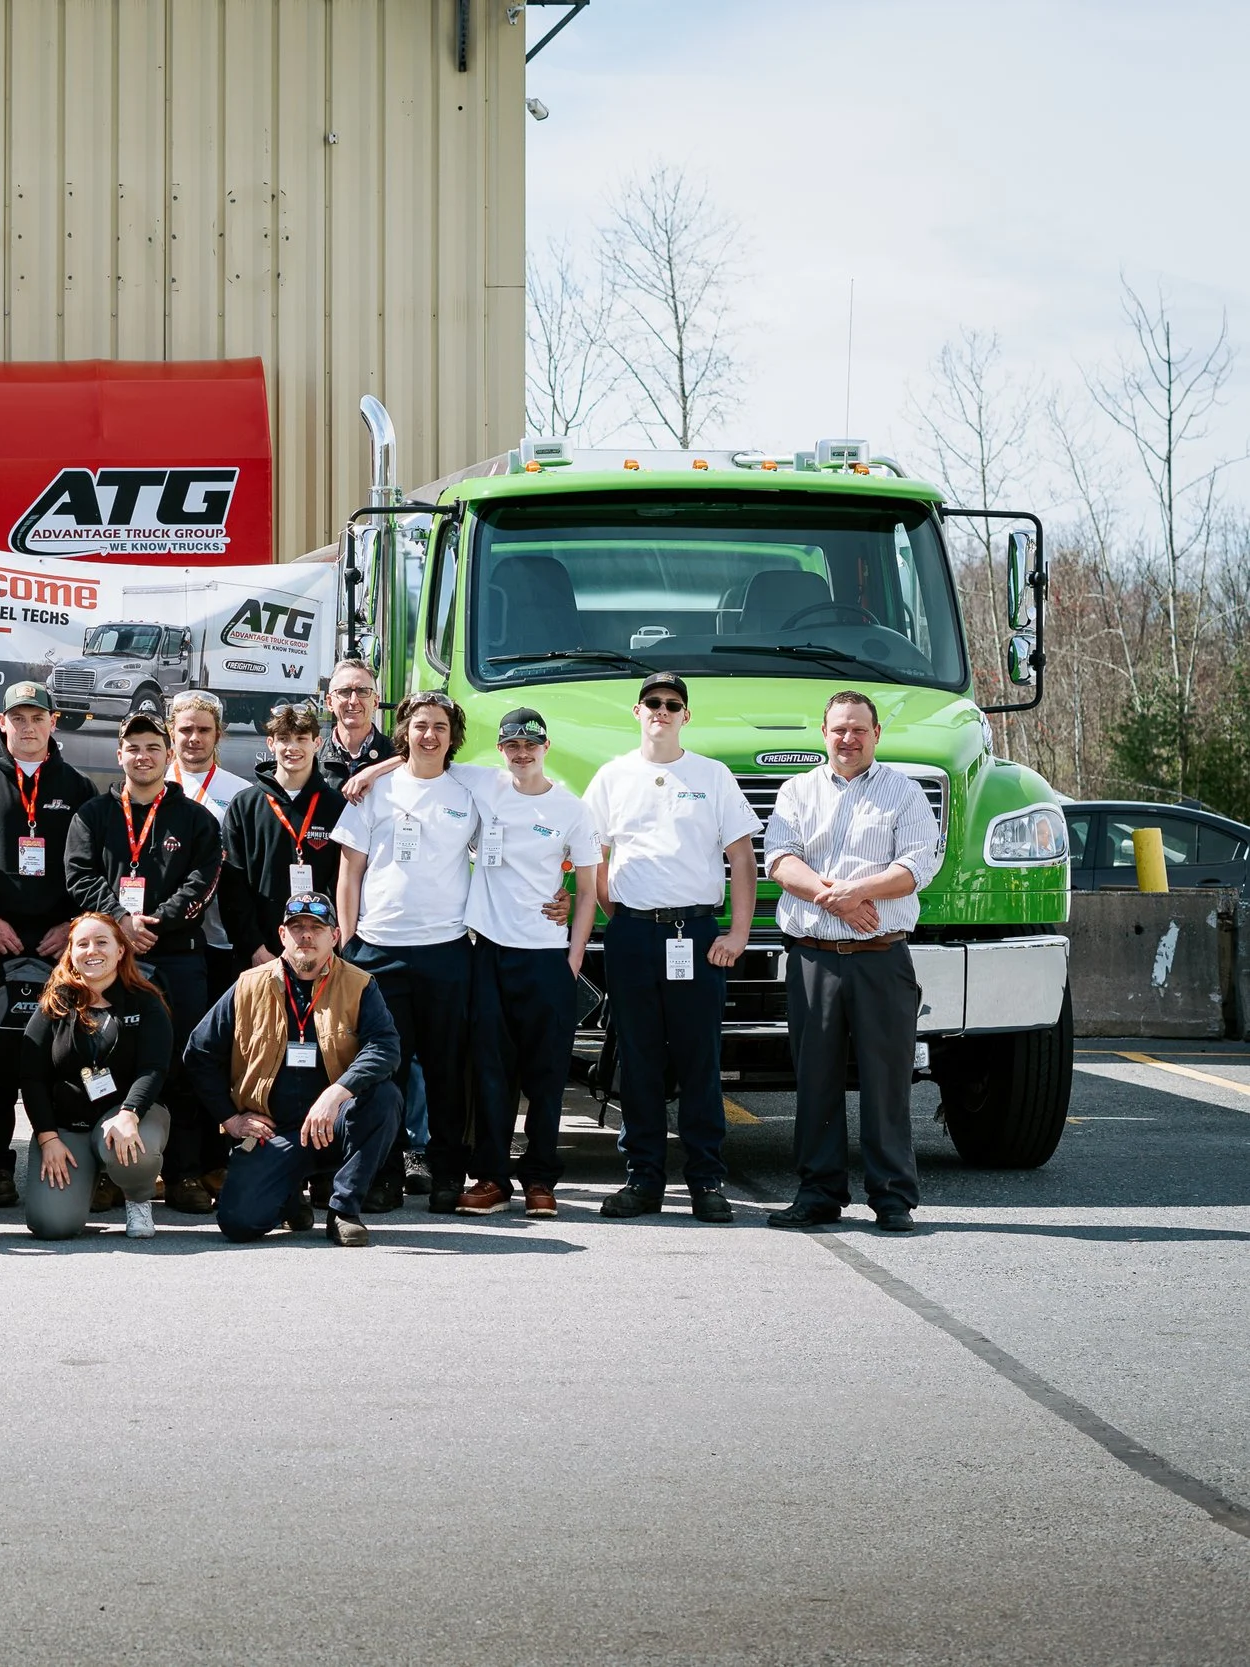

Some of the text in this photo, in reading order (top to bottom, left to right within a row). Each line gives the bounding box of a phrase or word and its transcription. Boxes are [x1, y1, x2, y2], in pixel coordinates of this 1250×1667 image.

[24, 470, 237, 525] ATG
[31, 529, 225, 539] ADVANTAGE TRUCK GROUP
[109, 543, 224, 551] WE KNOW TRUCKS.
[22, 608, 70, 626] TECHS
[224, 599, 315, 641] ATG
[230, 630, 270, 642] ADVANTAGE
[270, 636, 289, 645] TRUCK
[226, 661, 266, 673] FREIGHTLINER
[763, 754, 820, 763] FREIGHTLINER
[124, 1014, 141, 1024] TG
